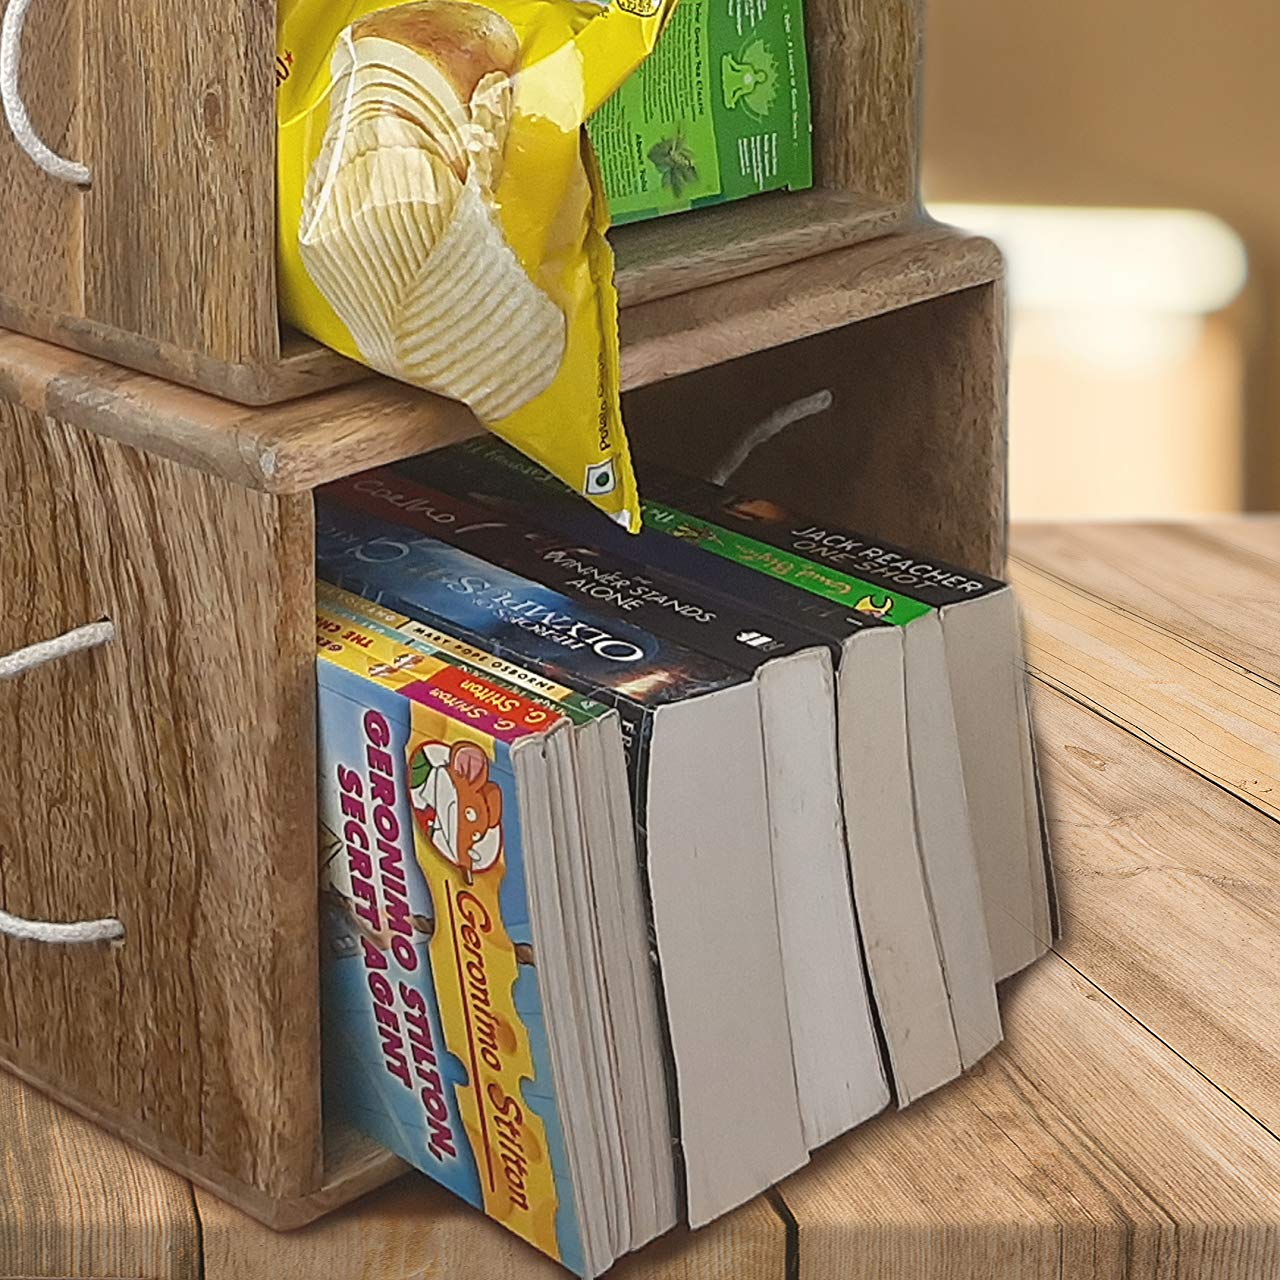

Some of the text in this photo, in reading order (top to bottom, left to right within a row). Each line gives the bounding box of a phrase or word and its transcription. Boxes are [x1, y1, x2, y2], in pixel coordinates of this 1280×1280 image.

[542, 549, 717, 624] WINNER STANDS
[792, 526, 984, 593] JACK REACHER
[792, 540, 938, 589] ONE SHOT
[446, 575, 645, 662] OLYMPUS
[565, 578, 645, 611] ALONE
[341, 630, 375, 649] THE
[412, 627, 557, 692] MARY POPE OSBORNE
[429, 687, 489, 720] Stilton
[460, 679, 521, 713] Stilton
[337, 763, 413, 1090] SECRET AGENT
[364, 709, 457, 1163] GERONIMO STILTON,
[456, 889, 530, 1212] Geronimo Stilton
